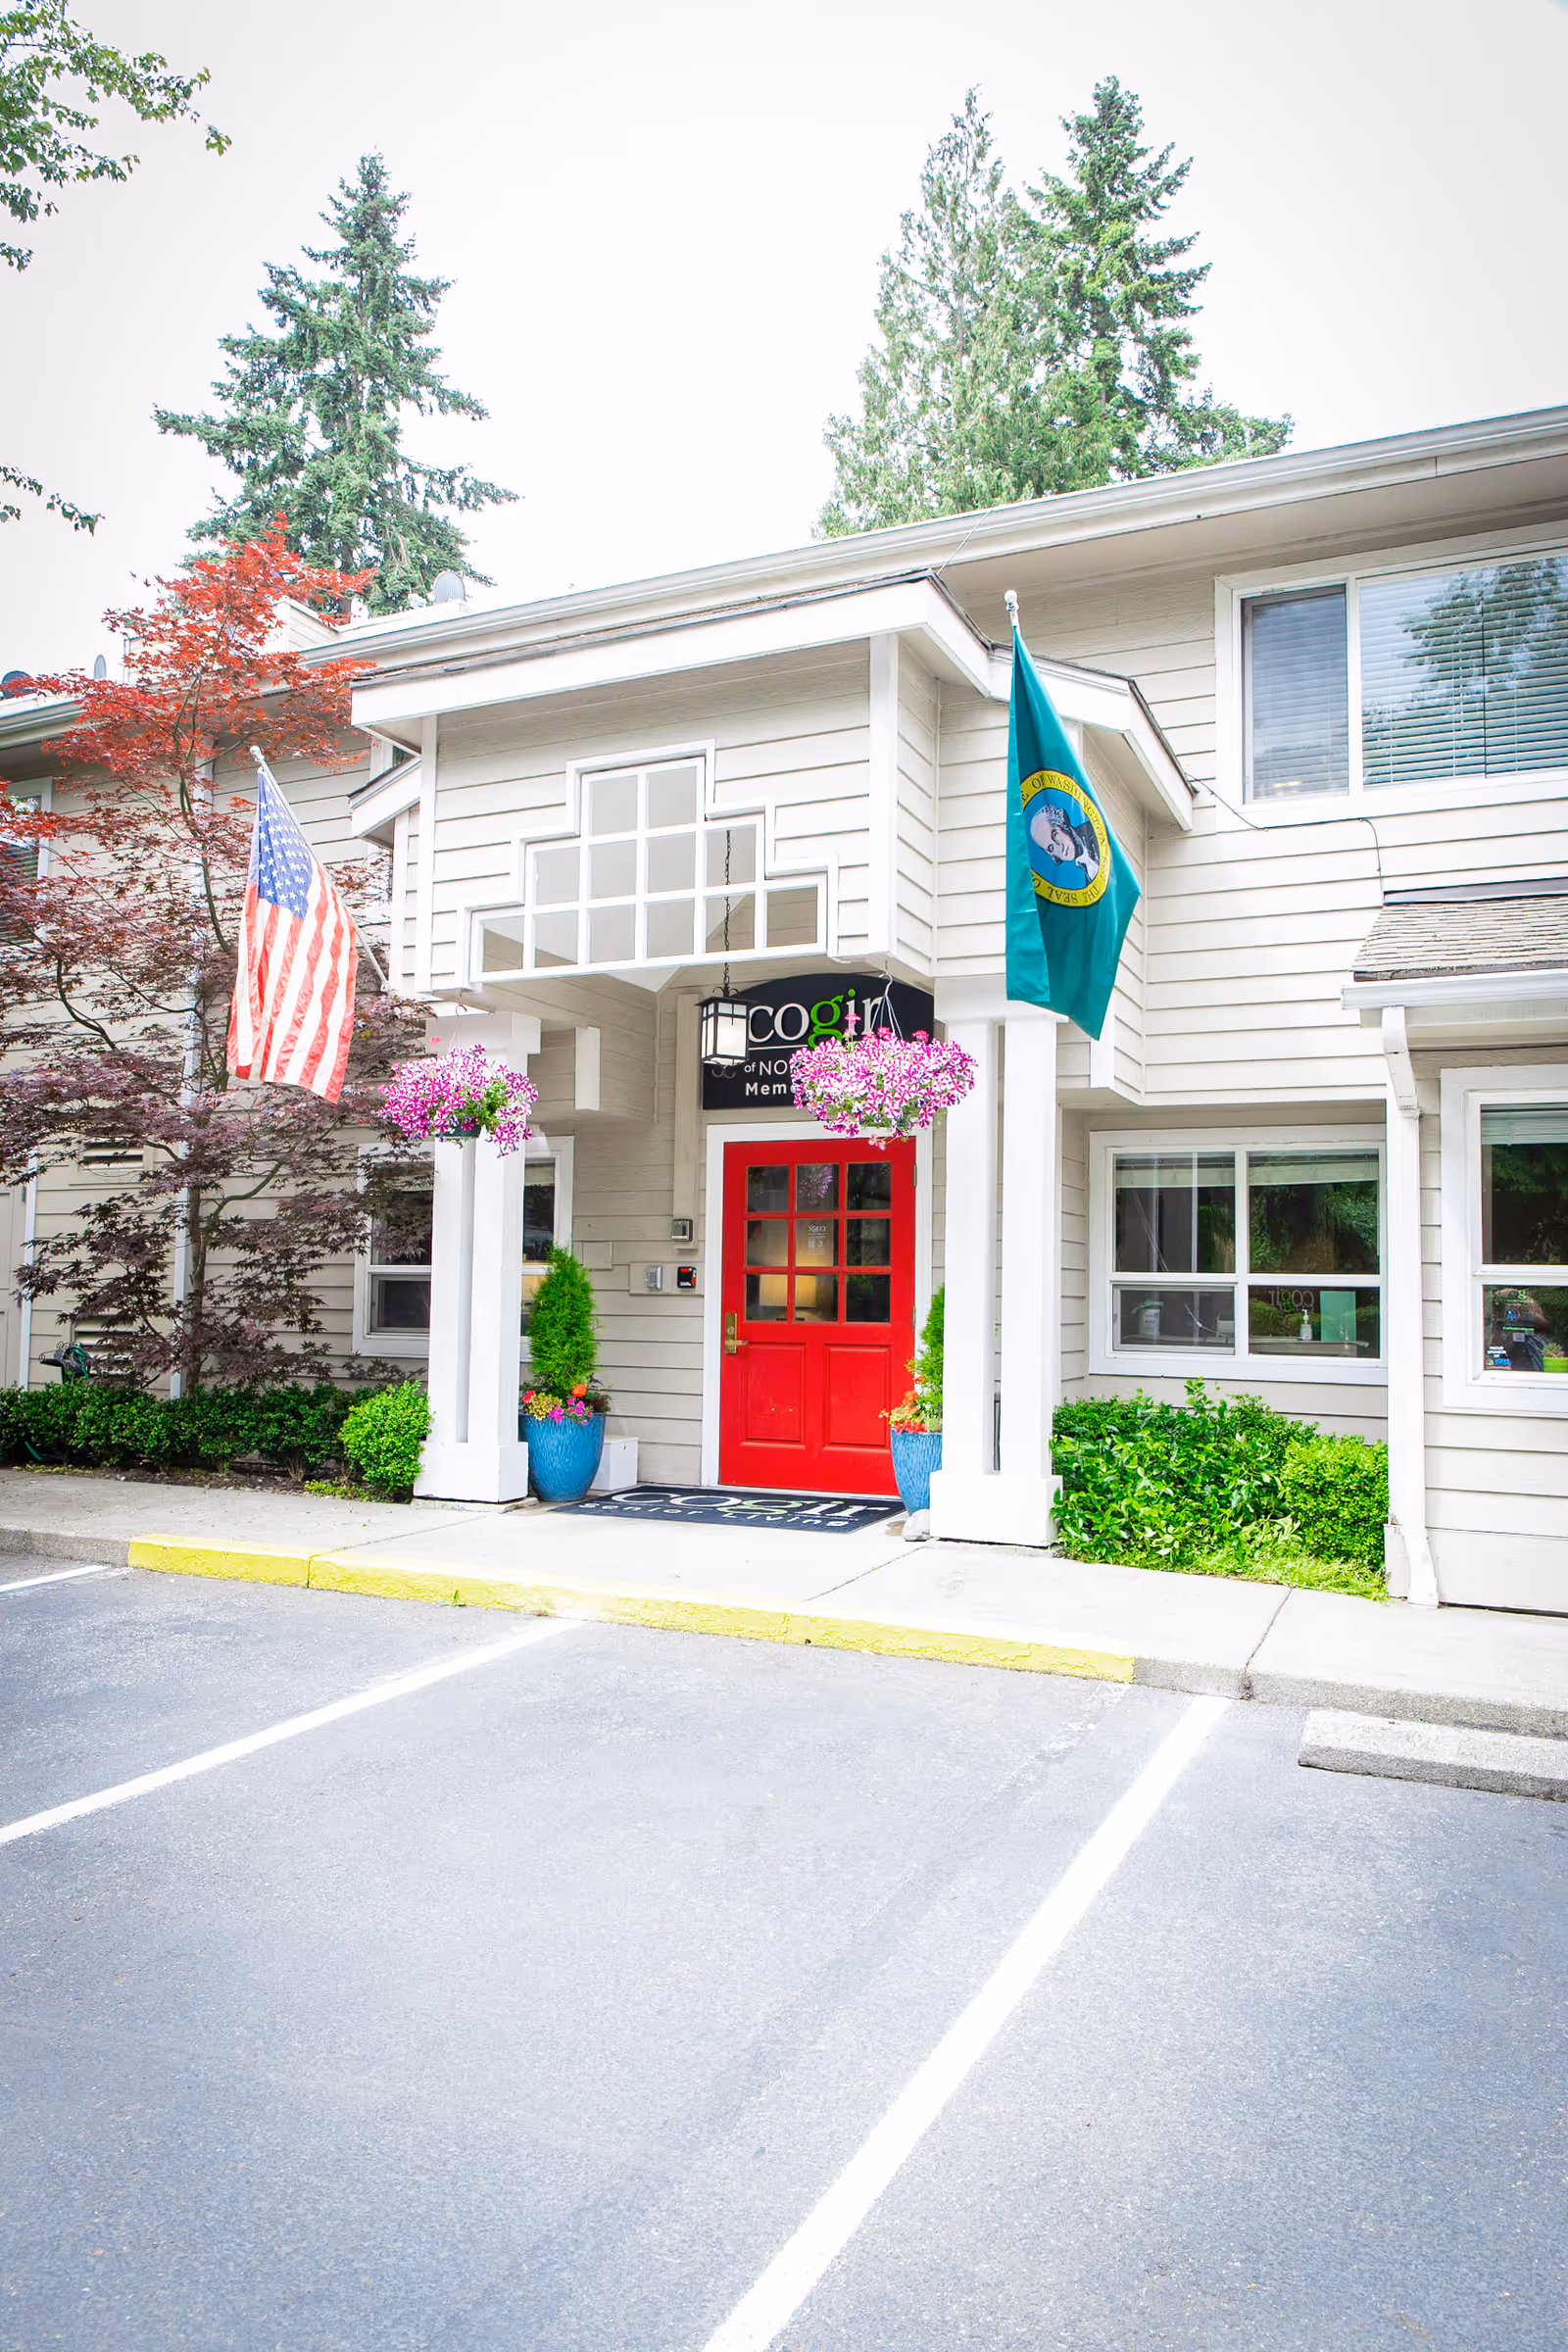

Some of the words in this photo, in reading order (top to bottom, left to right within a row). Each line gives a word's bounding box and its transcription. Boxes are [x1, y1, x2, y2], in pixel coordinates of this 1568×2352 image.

[1047, 886, 1079, 904] SEAL
[743, 1061, 757, 1073] of
[760, 1059, 793, 1076] NO
[578, 1502, 704, 1515] Senior
[721, 1513, 850, 1527] Living
[612, 1492, 889, 1517] cogir
